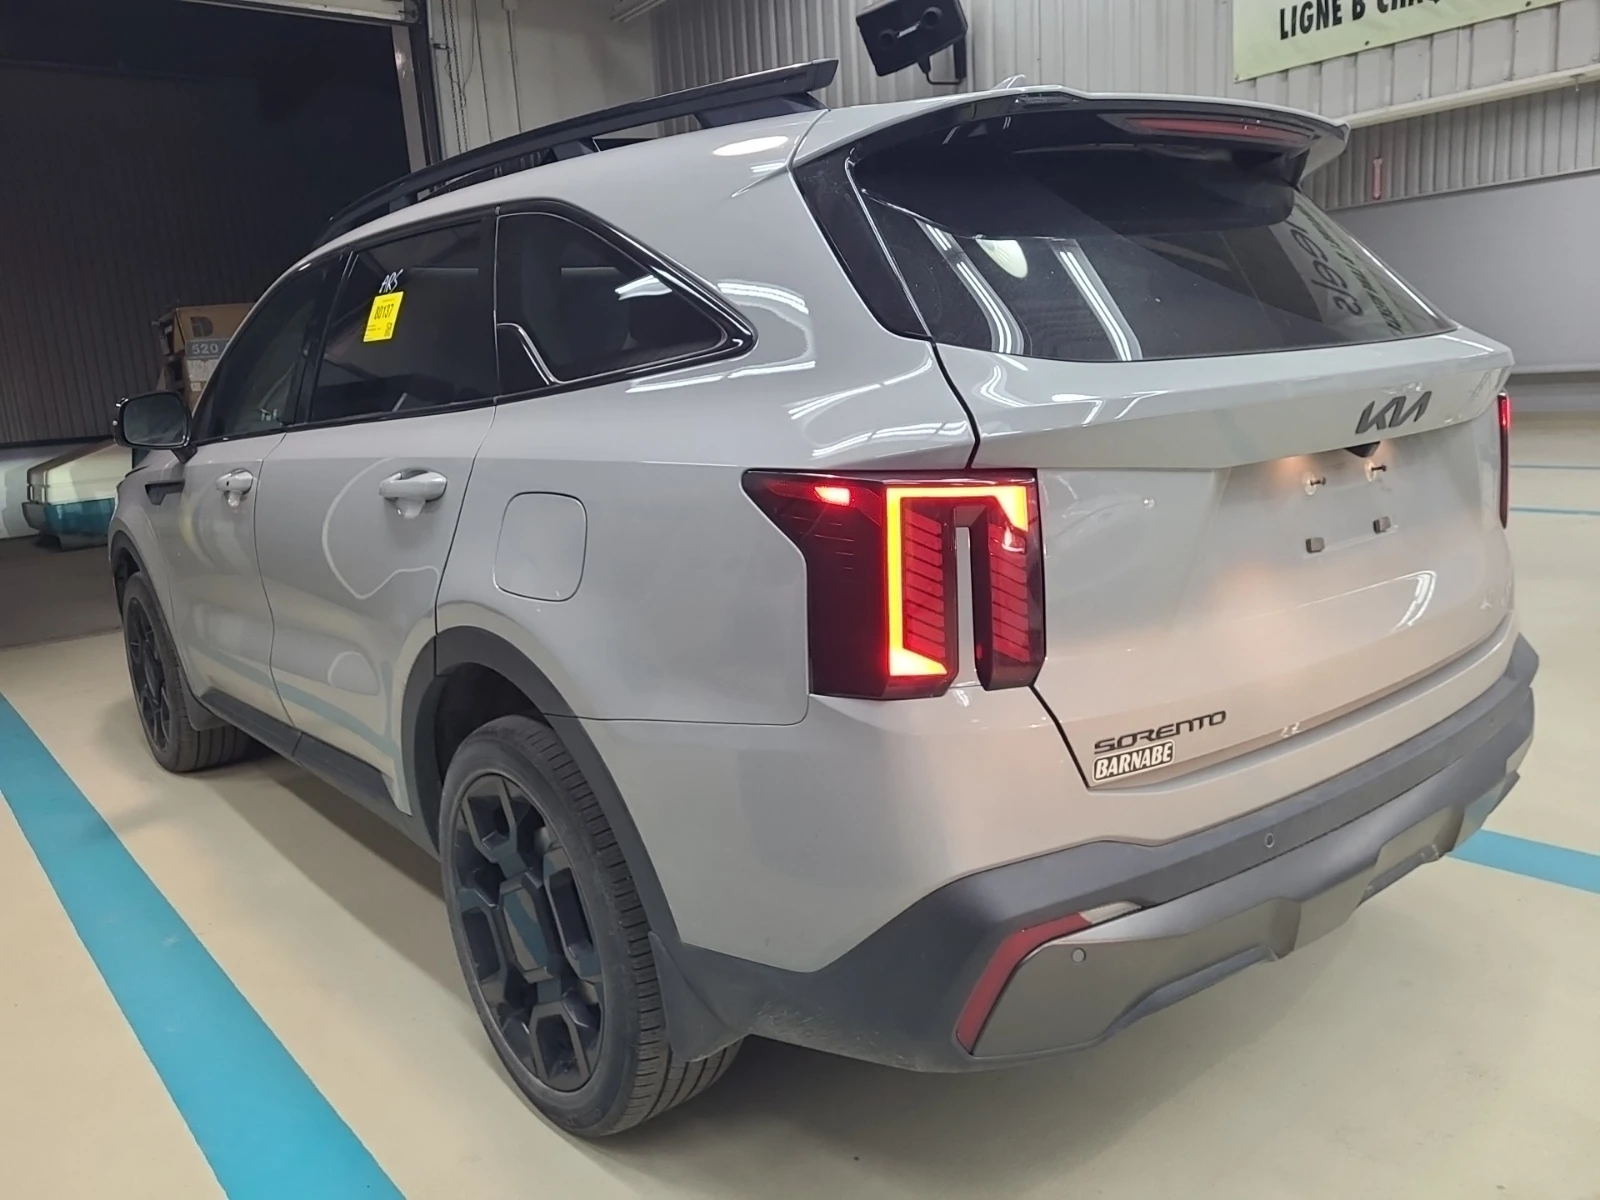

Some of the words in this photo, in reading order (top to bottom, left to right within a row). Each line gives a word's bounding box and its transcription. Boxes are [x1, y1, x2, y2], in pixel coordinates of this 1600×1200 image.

[1280, 0, 1342, 40] LIGNE
[191, 343, 218, 354] 520
[1355, 391, 1432, 435] KIA
[1094, 710, 1226, 755] SORENTO
[1095, 742, 1173, 780] BARNABE
